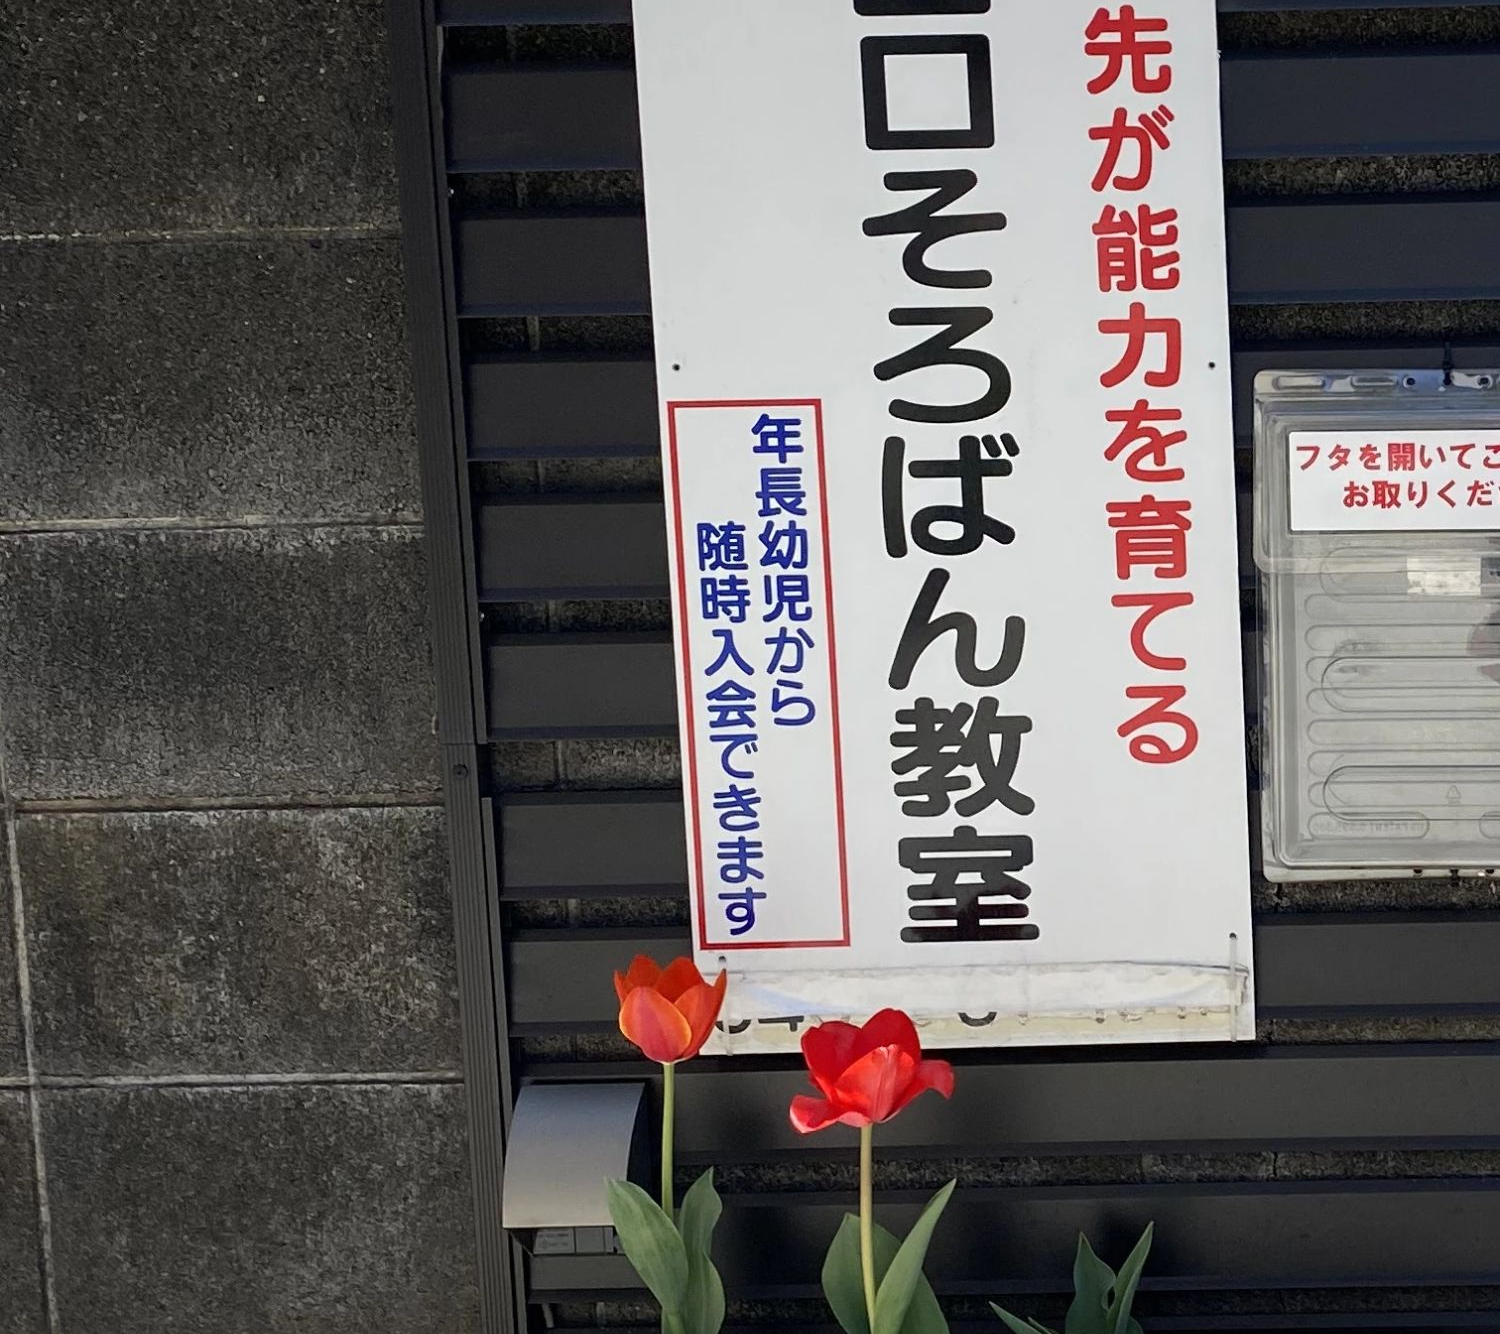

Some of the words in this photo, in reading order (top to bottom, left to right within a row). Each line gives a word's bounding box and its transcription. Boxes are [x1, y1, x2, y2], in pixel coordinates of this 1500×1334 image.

[696, 521, 768, 936] 随時入会できます
[751, 413, 816, 727] 年長幼児から
